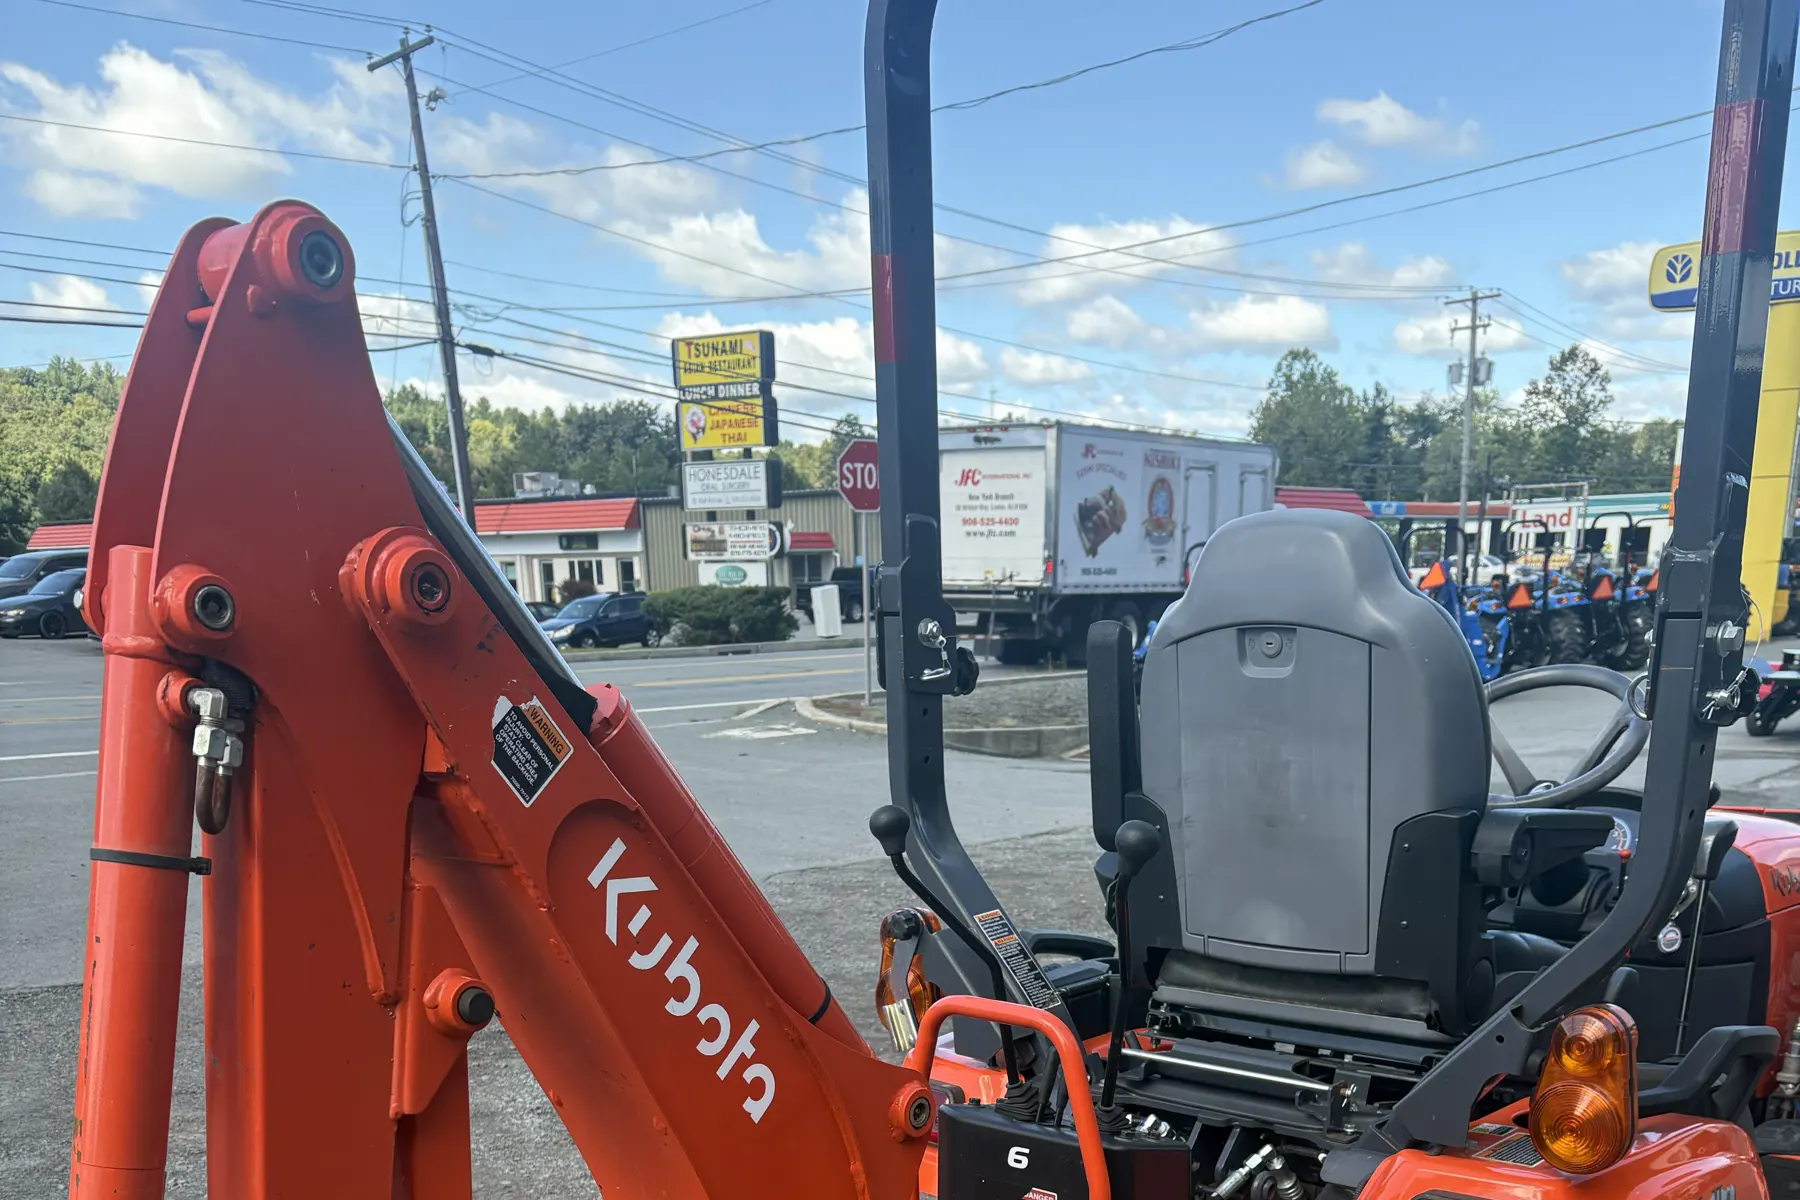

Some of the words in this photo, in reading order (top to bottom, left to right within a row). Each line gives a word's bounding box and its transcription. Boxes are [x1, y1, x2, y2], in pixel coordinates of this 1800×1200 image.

[685, 339, 743, 359] TSUNAMI
[707, 356, 757, 372] RESTAURANT
[680, 386, 716, 400] LUNCH
[717, 382, 760, 398] DINNER
[710, 418, 759, 430] JAPANESE
[720, 432, 748, 444] THAI
[688, 466, 761, 482] HONESDALE
[841, 462, 880, 490] STO
[954, 468, 982, 487] JFC
[721, 482, 751, 491] SURGERY
[1521, 507, 1572, 529] Land
[509, 711, 518, 721] TO
[516, 720, 532, 740] AVOID
[530, 739, 554, 771] PERSONAL
[530, 708, 564, 754] WARNING
[499, 729, 525, 763] OPERATING
[524, 762, 538, 780] AREA
[503, 723, 517, 740] STAY
[515, 740, 532, 761] CLEAR
[531, 759, 539, 768] OF
[495, 734, 504, 743] OF
[502, 743, 513, 756] THE
[511, 755, 534, 786] BACKHOE.
[587, 837, 776, 1124] Kubota
[1007, 1146, 1030, 1169] 6
